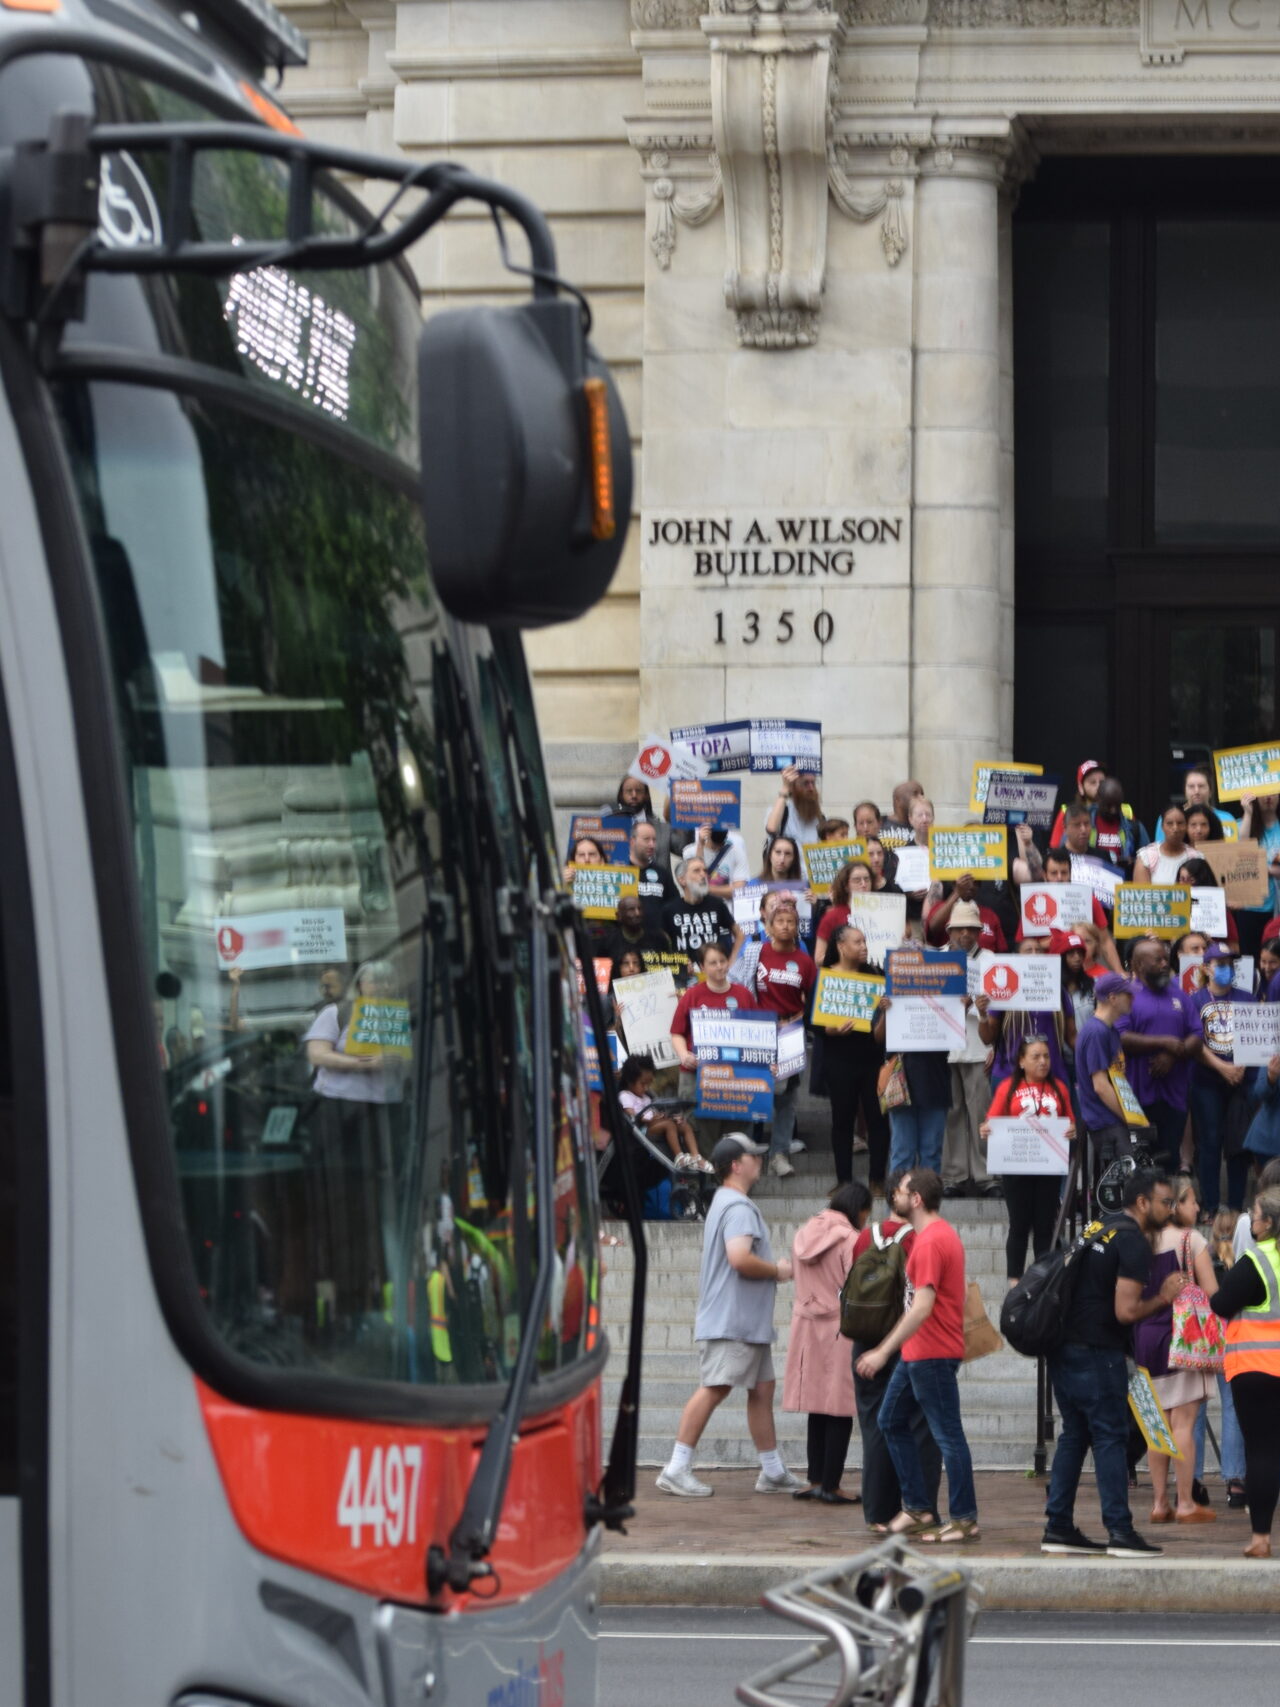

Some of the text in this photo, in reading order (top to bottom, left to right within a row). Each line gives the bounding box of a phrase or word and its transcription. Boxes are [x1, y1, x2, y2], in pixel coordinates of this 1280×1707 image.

[650, 518, 903, 545] JOHN A. WILSON
[694, 551, 855, 577] BUILDING
[714, 609, 835, 646] 1350
[690, 736, 732, 758] TOPA
[752, 756, 774, 770] JOBS
[1220, 748, 1280, 768] INVEST IN
[1222, 763, 1265, 780] KIDS &
[1223, 773, 1280, 791] FAMILIES
[985, 810, 1006, 823] JOBS
[935, 831, 1000, 845] INVEST IN
[807, 845, 863, 861] INVEST IN
[934, 844, 980, 856] KIDS &
[809, 860, 834, 872] KIDS
[935, 856, 996, 869] FAMILIES
[621, 872, 634, 885] IN
[573, 881, 603, 894] KIDS
[1119, 889, 1186, 903] INVEST IN
[1119, 903, 1167, 915] KIDS &
[1119, 915, 1181, 928] FAMILIES
[891, 952, 920, 963] Solid
[890, 964, 960, 975] Foundations
[824, 976, 873, 994] INVEST
[822, 990, 868, 1007] KIDS &
[820, 1002, 873, 1021] FAMILIE
[1234, 1008, 1253, 1018] PAY
[1234, 1021, 1260, 1032] EARLY
[695, 1047, 776, 1065] JOBS JUSTICE
[702, 1068, 730, 1079] Solid
[702, 1080, 767, 1092] Foundations
[702, 1092, 721, 1101] Not
[335, 1444, 423, 1548] 4497
